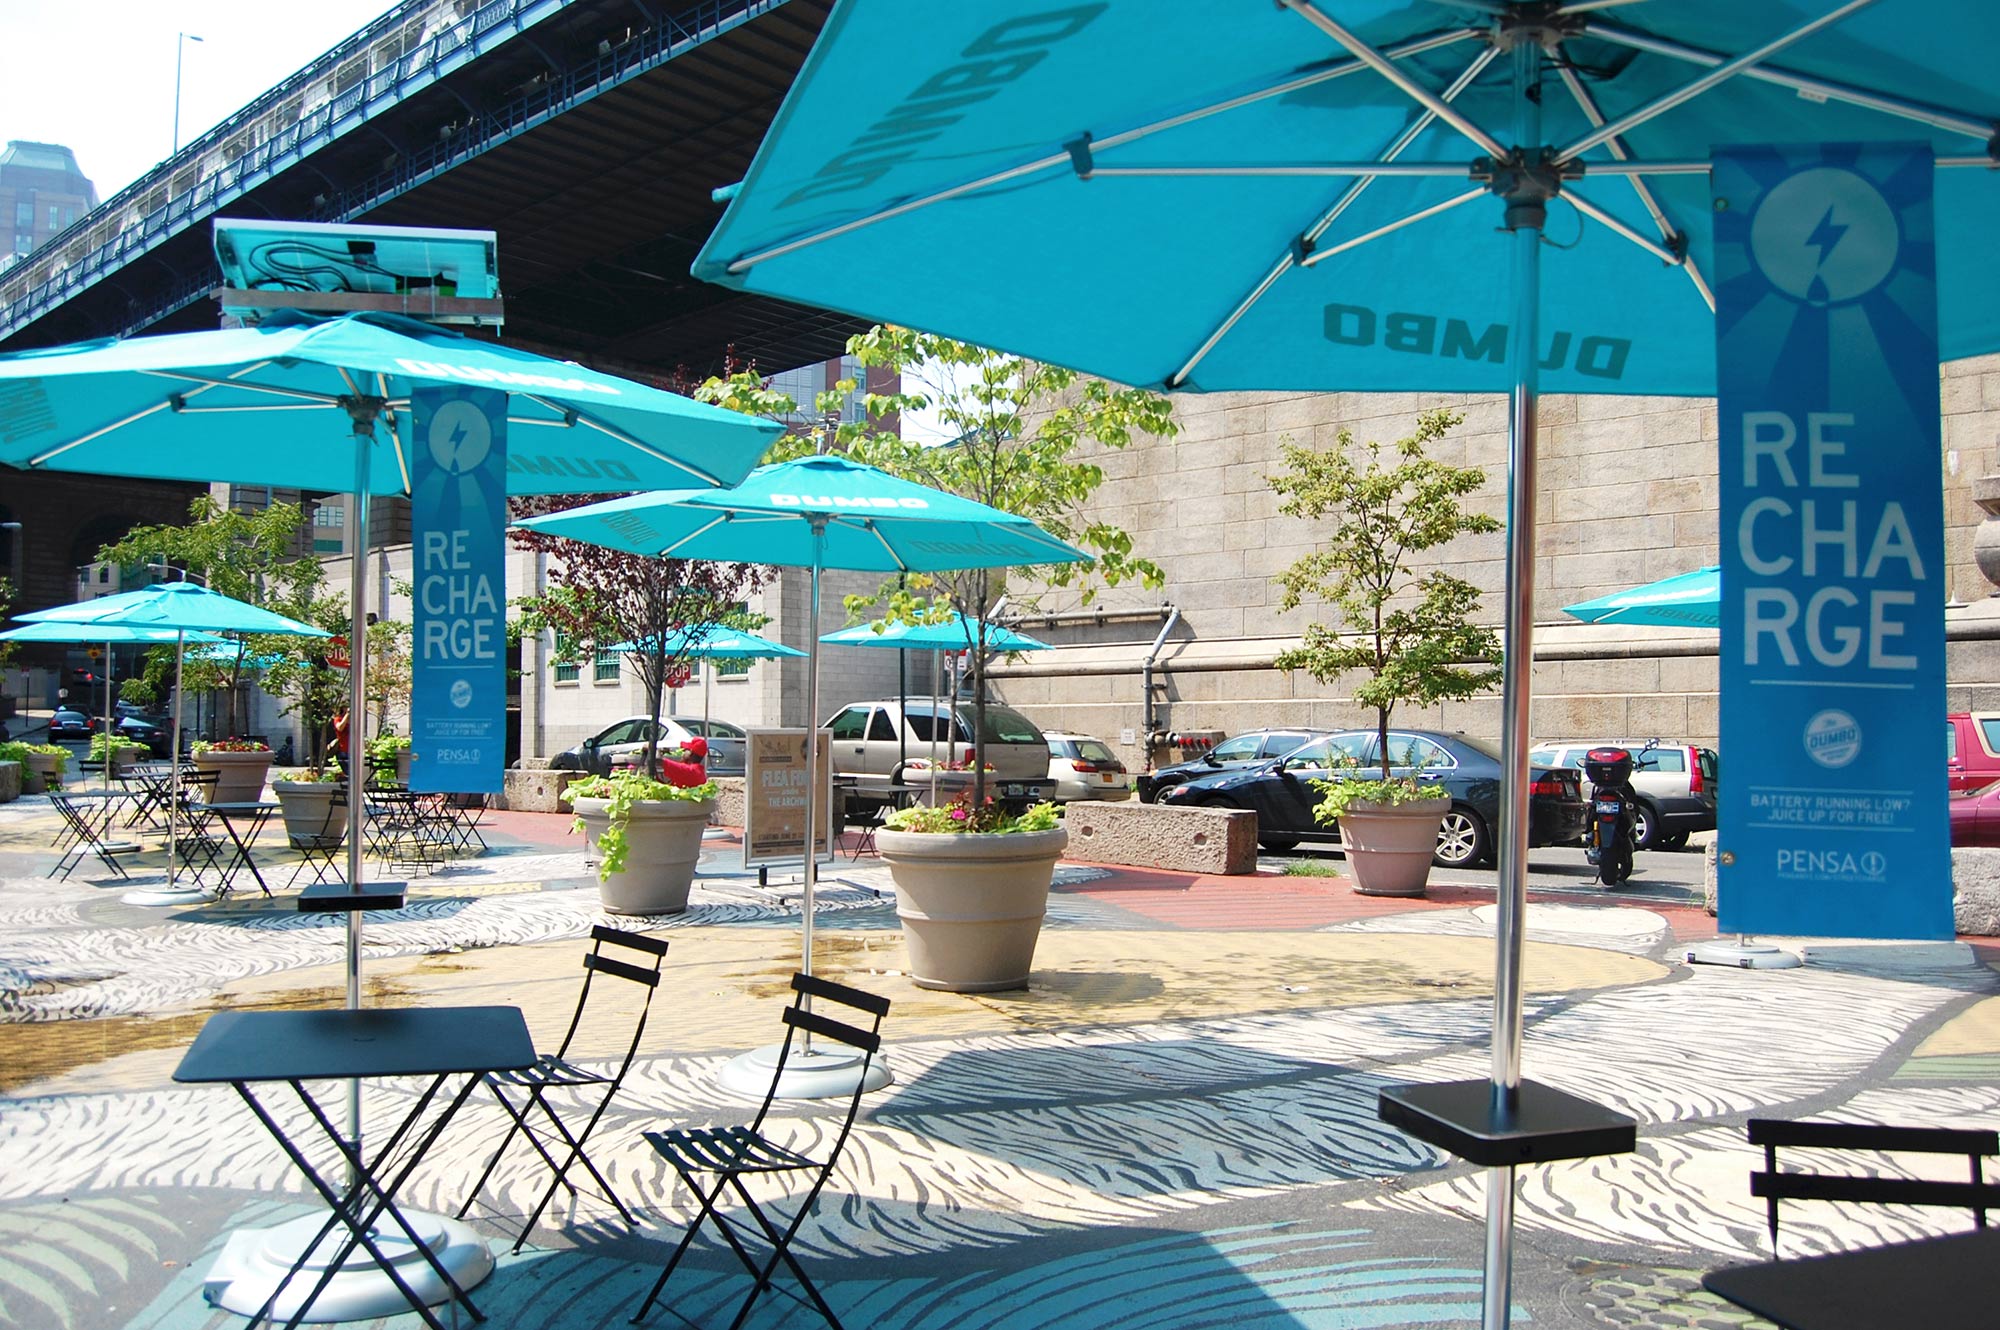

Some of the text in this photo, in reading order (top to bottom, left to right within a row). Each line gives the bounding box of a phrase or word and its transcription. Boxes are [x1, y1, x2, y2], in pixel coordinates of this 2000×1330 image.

[1742, 411, 1860, 487] RE
[769, 494, 929, 509] DUMBO
[1738, 496, 1926, 580] CHA
[423, 530, 471, 571] RE
[421, 574, 498, 615] CHA
[424, 618, 496, 660] RGE
[1744, 586, 1918, 670] RGE
[437, 749, 470, 761] PENSA
[762, 770, 788, 787] FLEA
[768, 797, 781, 807] THE
[1750, 793, 1911, 811] BATTERY RUNNING LOW?
[1768, 808, 1894, 824] JUICE UP FOR FREE!
[1777, 849, 1858, 873] PENSA
